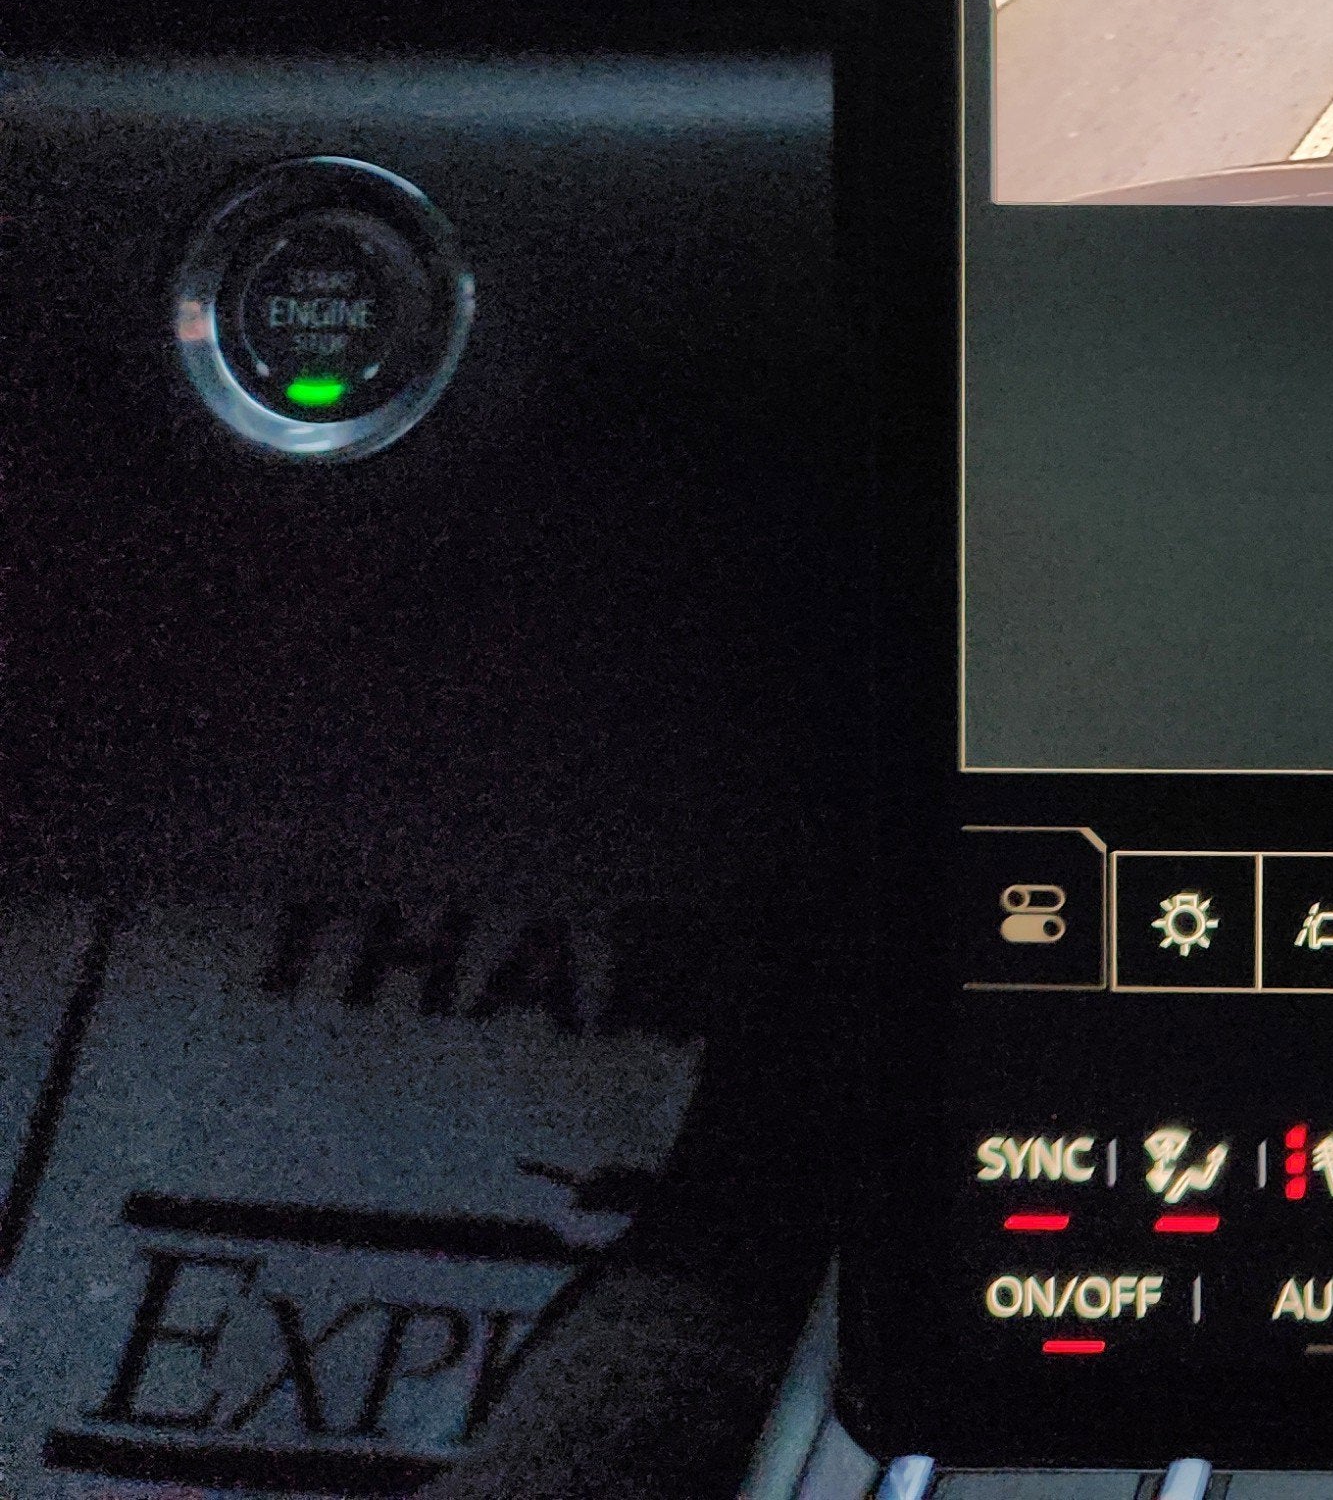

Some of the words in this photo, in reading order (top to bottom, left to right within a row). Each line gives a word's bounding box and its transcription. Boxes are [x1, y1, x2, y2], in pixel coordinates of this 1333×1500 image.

[268, 297, 376, 329] ENGINE
[976, 1135, 1096, 1182] SYNC
[985, 1274, 1165, 1320] ON/OFF
